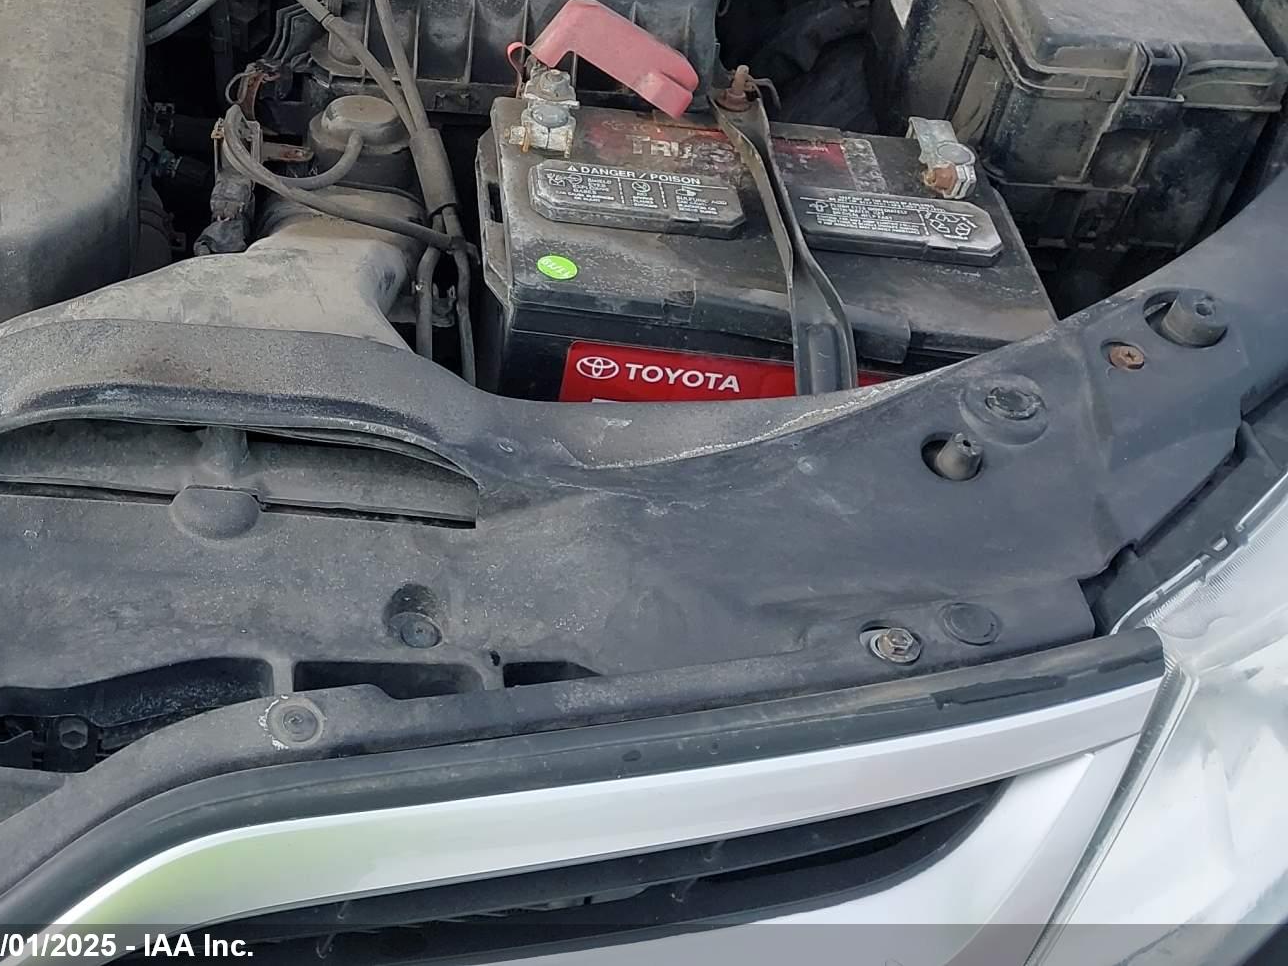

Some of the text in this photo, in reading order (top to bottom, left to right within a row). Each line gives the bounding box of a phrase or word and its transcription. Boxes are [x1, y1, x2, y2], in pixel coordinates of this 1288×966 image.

[580, 166, 636, 179] DANGER
[650, 173, 701, 185] POISON
[625, 362, 740, 393] TOYOTA
